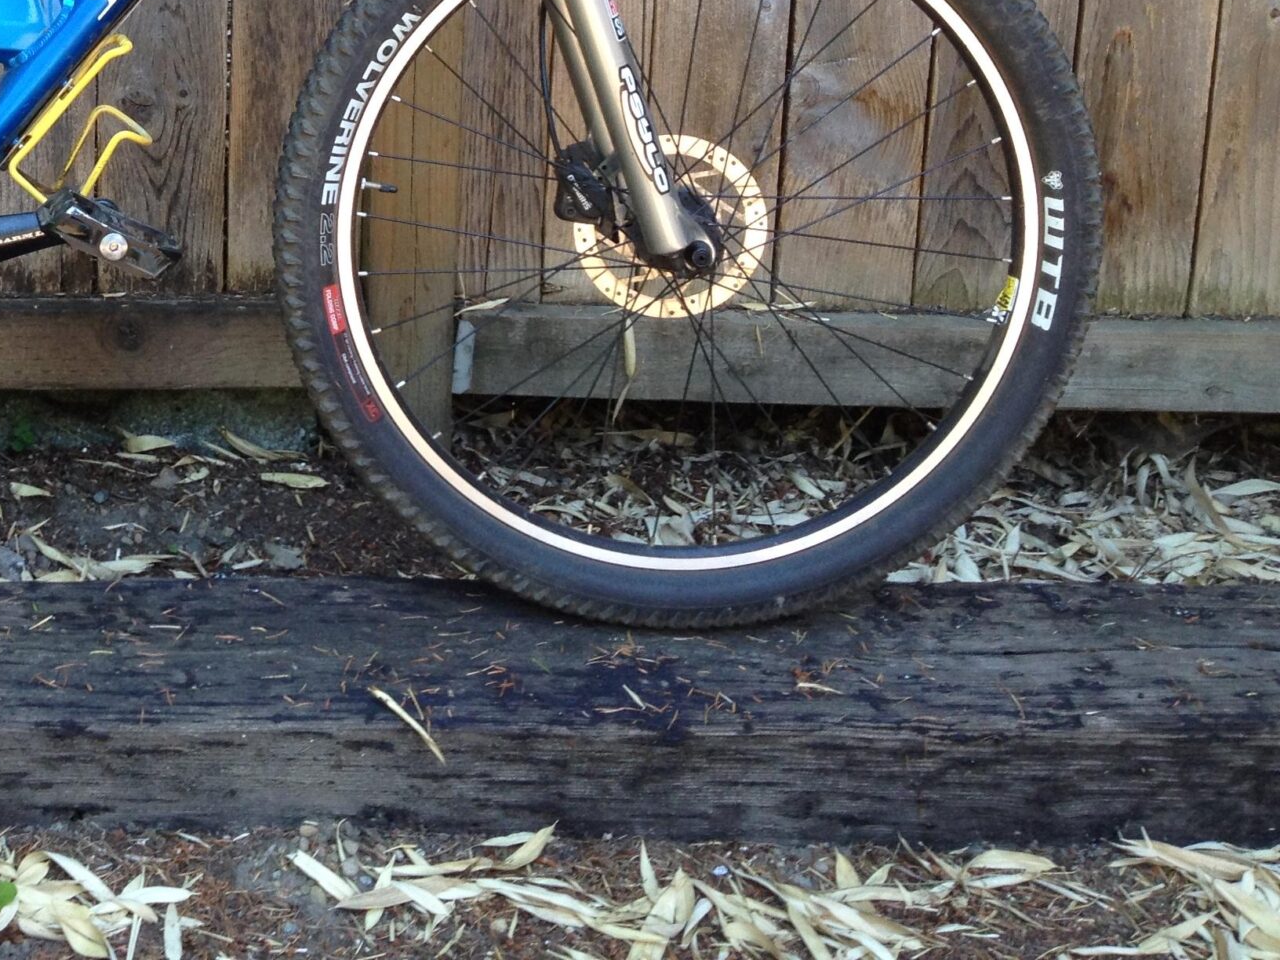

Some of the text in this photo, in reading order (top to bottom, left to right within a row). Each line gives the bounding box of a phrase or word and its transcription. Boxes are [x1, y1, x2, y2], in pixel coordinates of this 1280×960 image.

[320, 11, 422, 267] WOLVERINE 2.2
[619, 65, 669, 194] PSYLO
